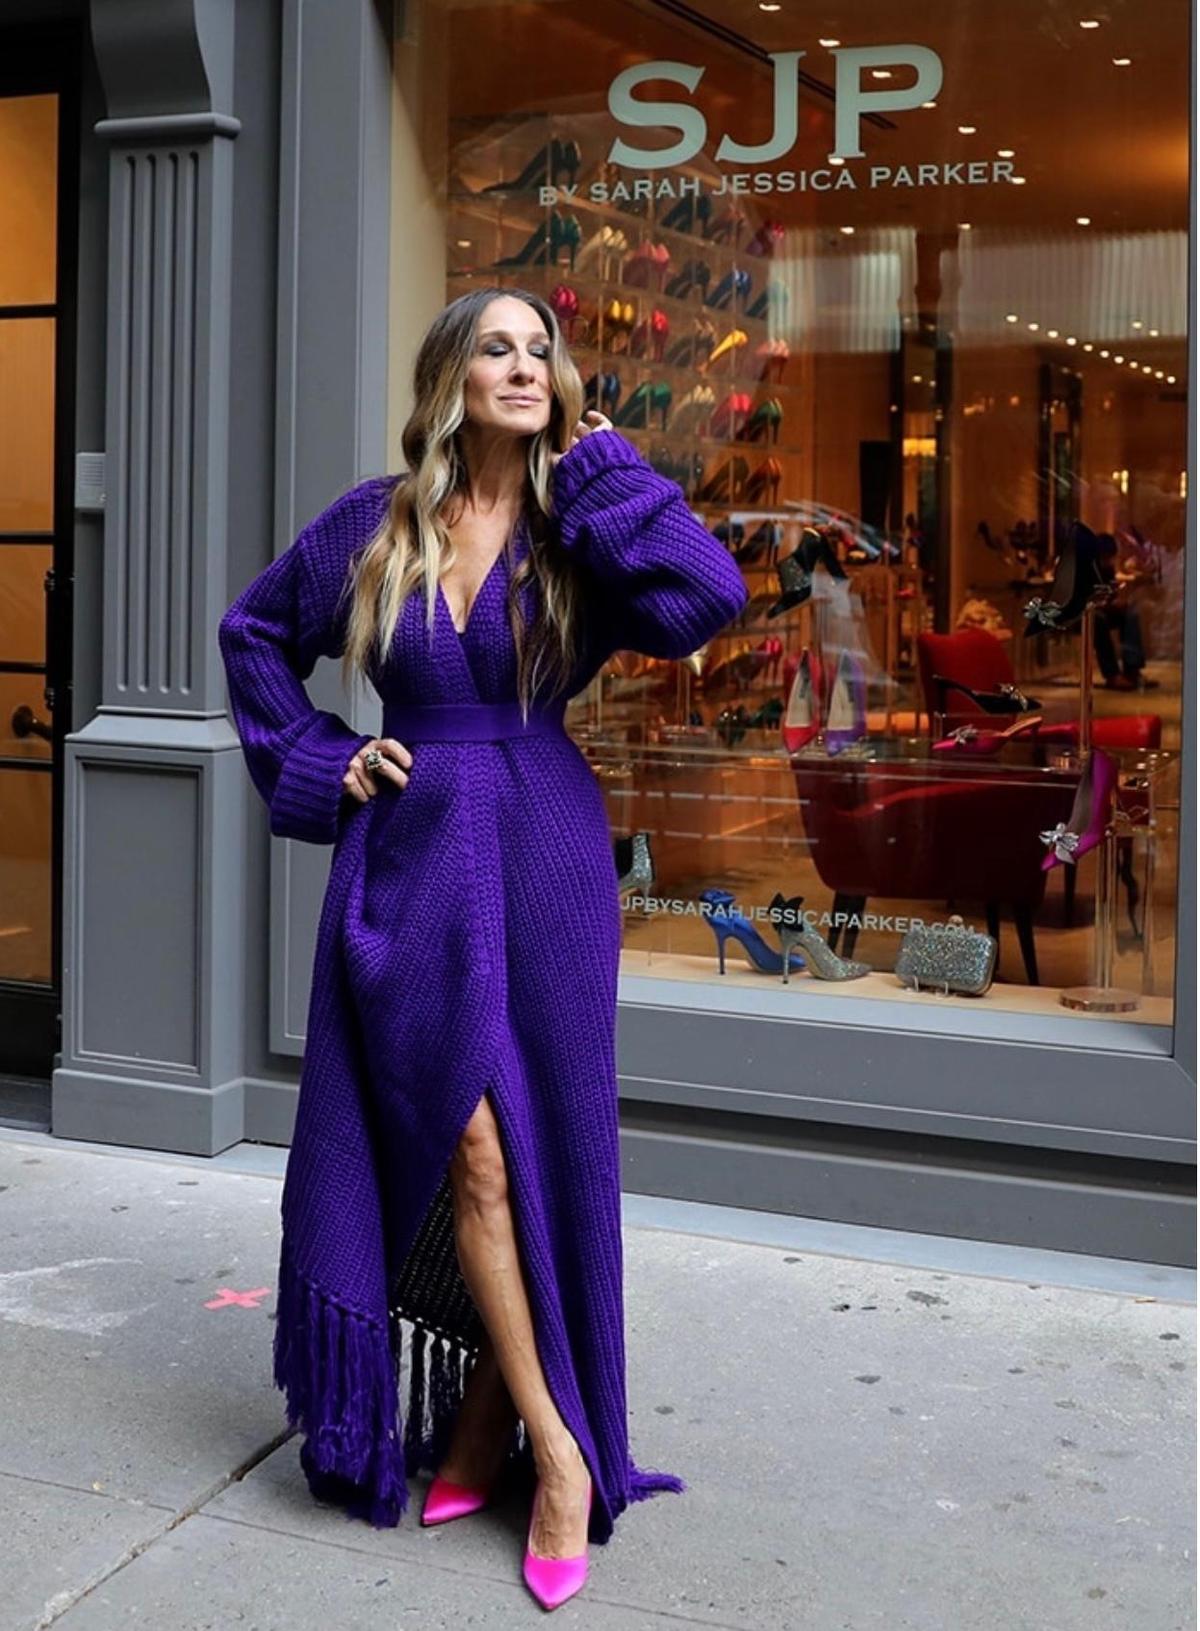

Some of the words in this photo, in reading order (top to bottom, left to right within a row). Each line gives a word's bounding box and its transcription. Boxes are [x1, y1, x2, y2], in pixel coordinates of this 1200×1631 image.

[608, 44, 943, 169] SJP
[539, 184, 577, 206] BY
[590, 177, 699, 202] SARAH
[712, 169, 857, 196] JESSICA
[870, 161, 1015, 189] PARKER
